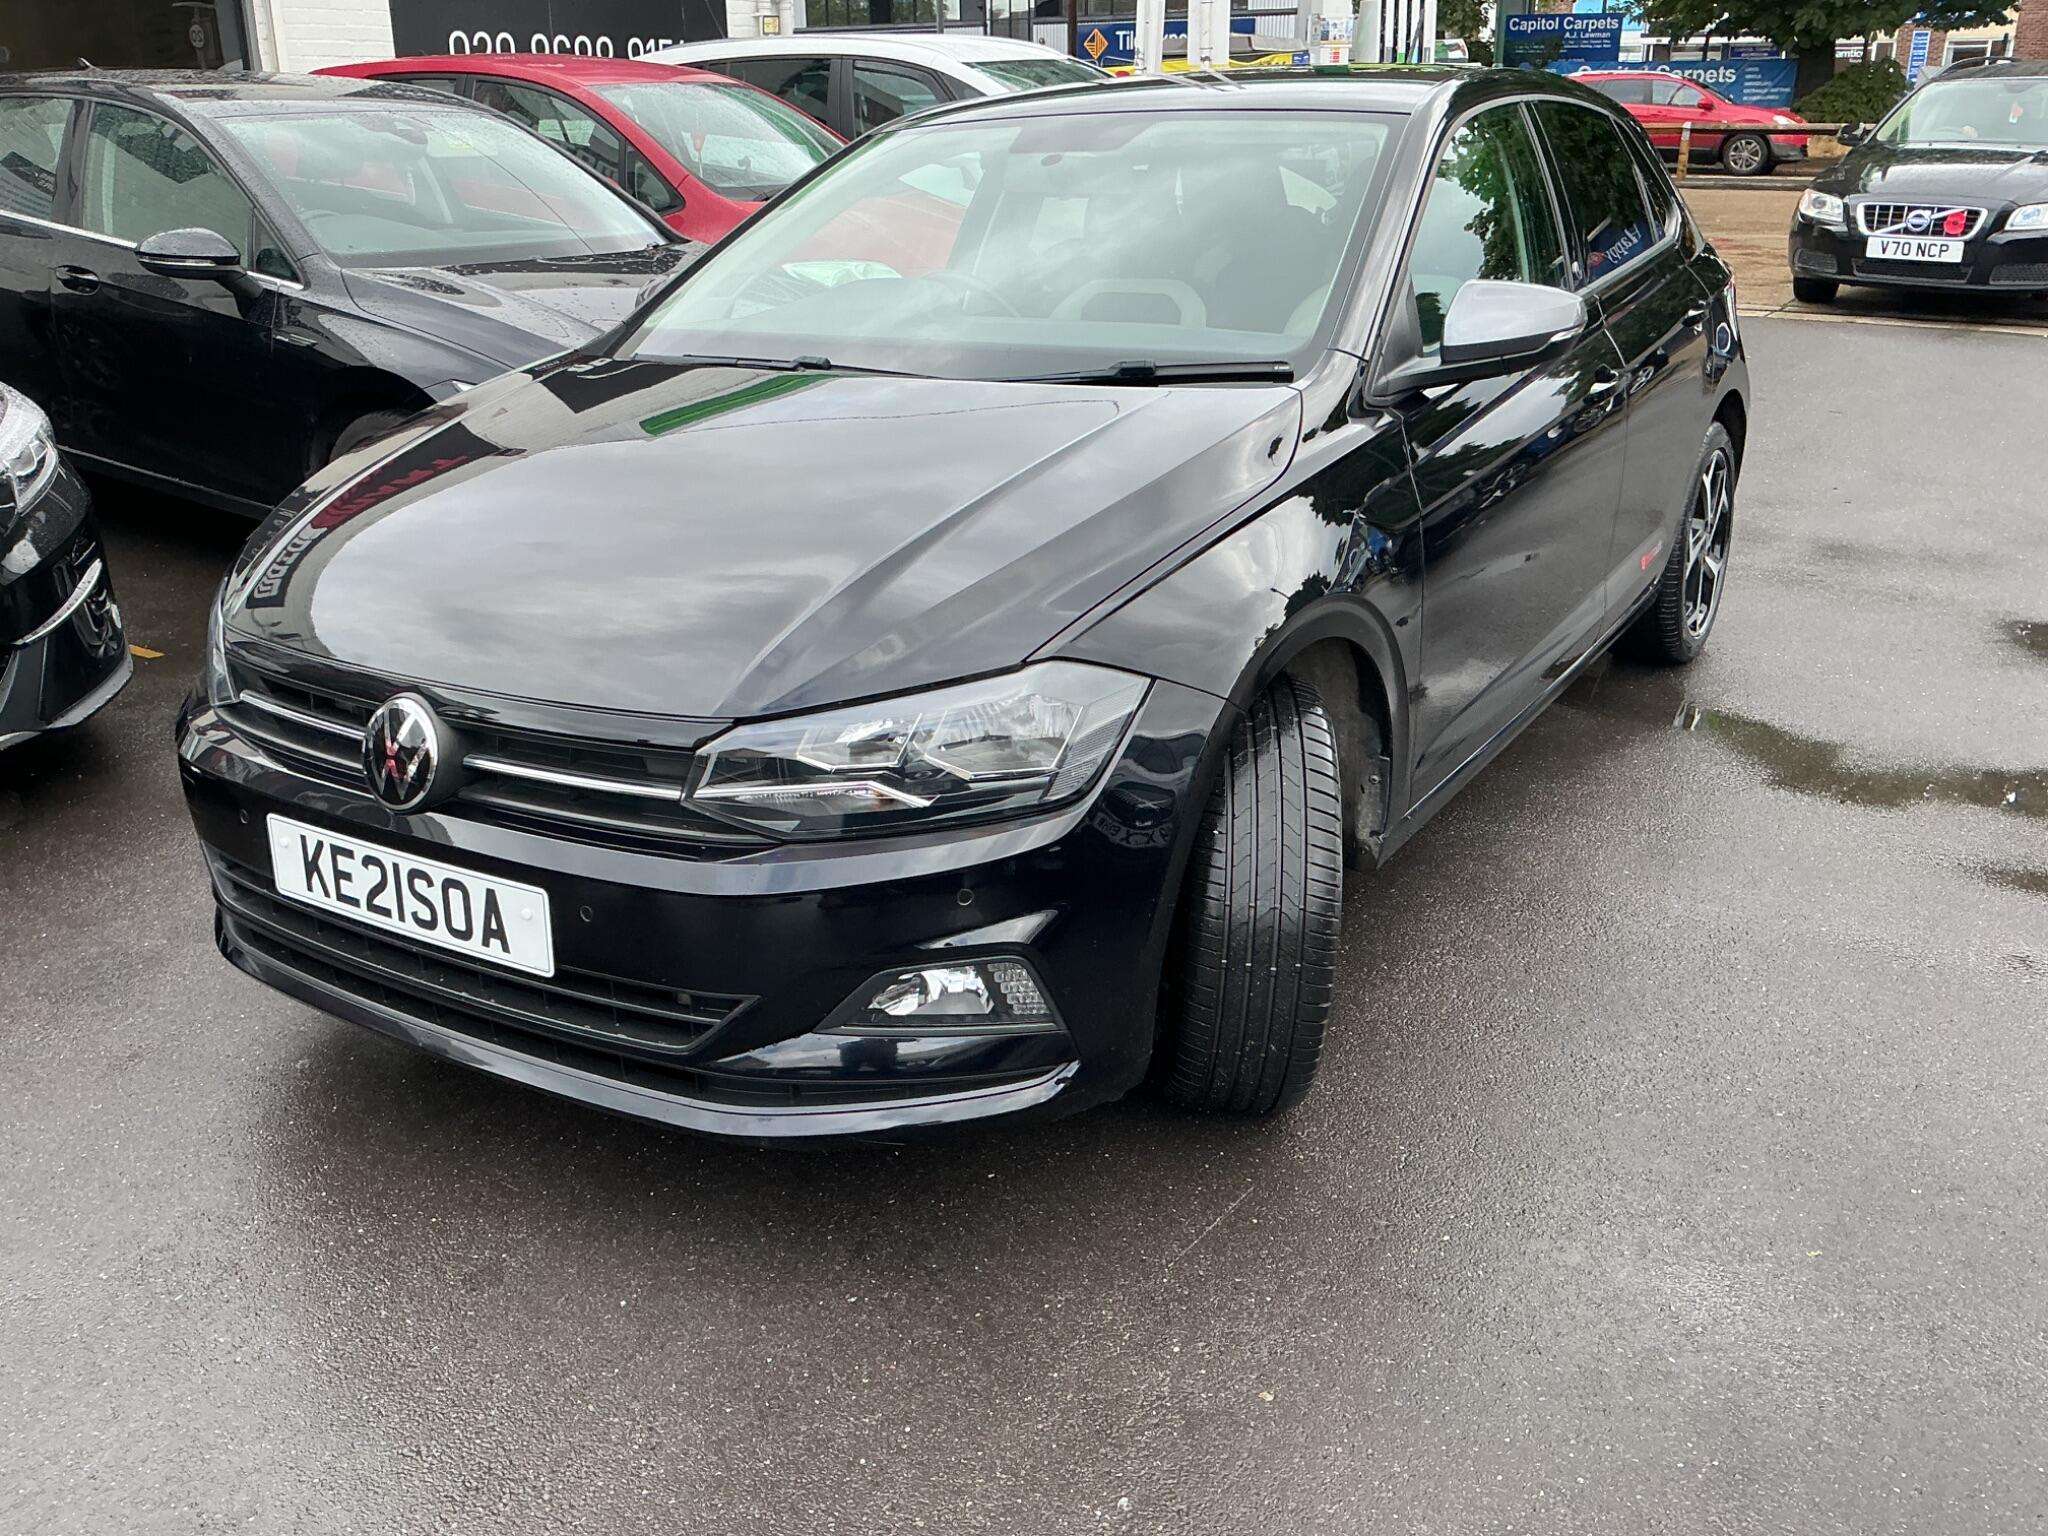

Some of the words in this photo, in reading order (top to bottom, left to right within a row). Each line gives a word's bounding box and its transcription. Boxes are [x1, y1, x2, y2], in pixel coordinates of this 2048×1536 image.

[1509, 17, 1559, 34] Capitol
[1563, 16, 1619, 32] Carpets
[1115, 30, 1136, 51] Til
[1881, 241, 1911, 256] V70
[1916, 242, 1950, 258] NCP
